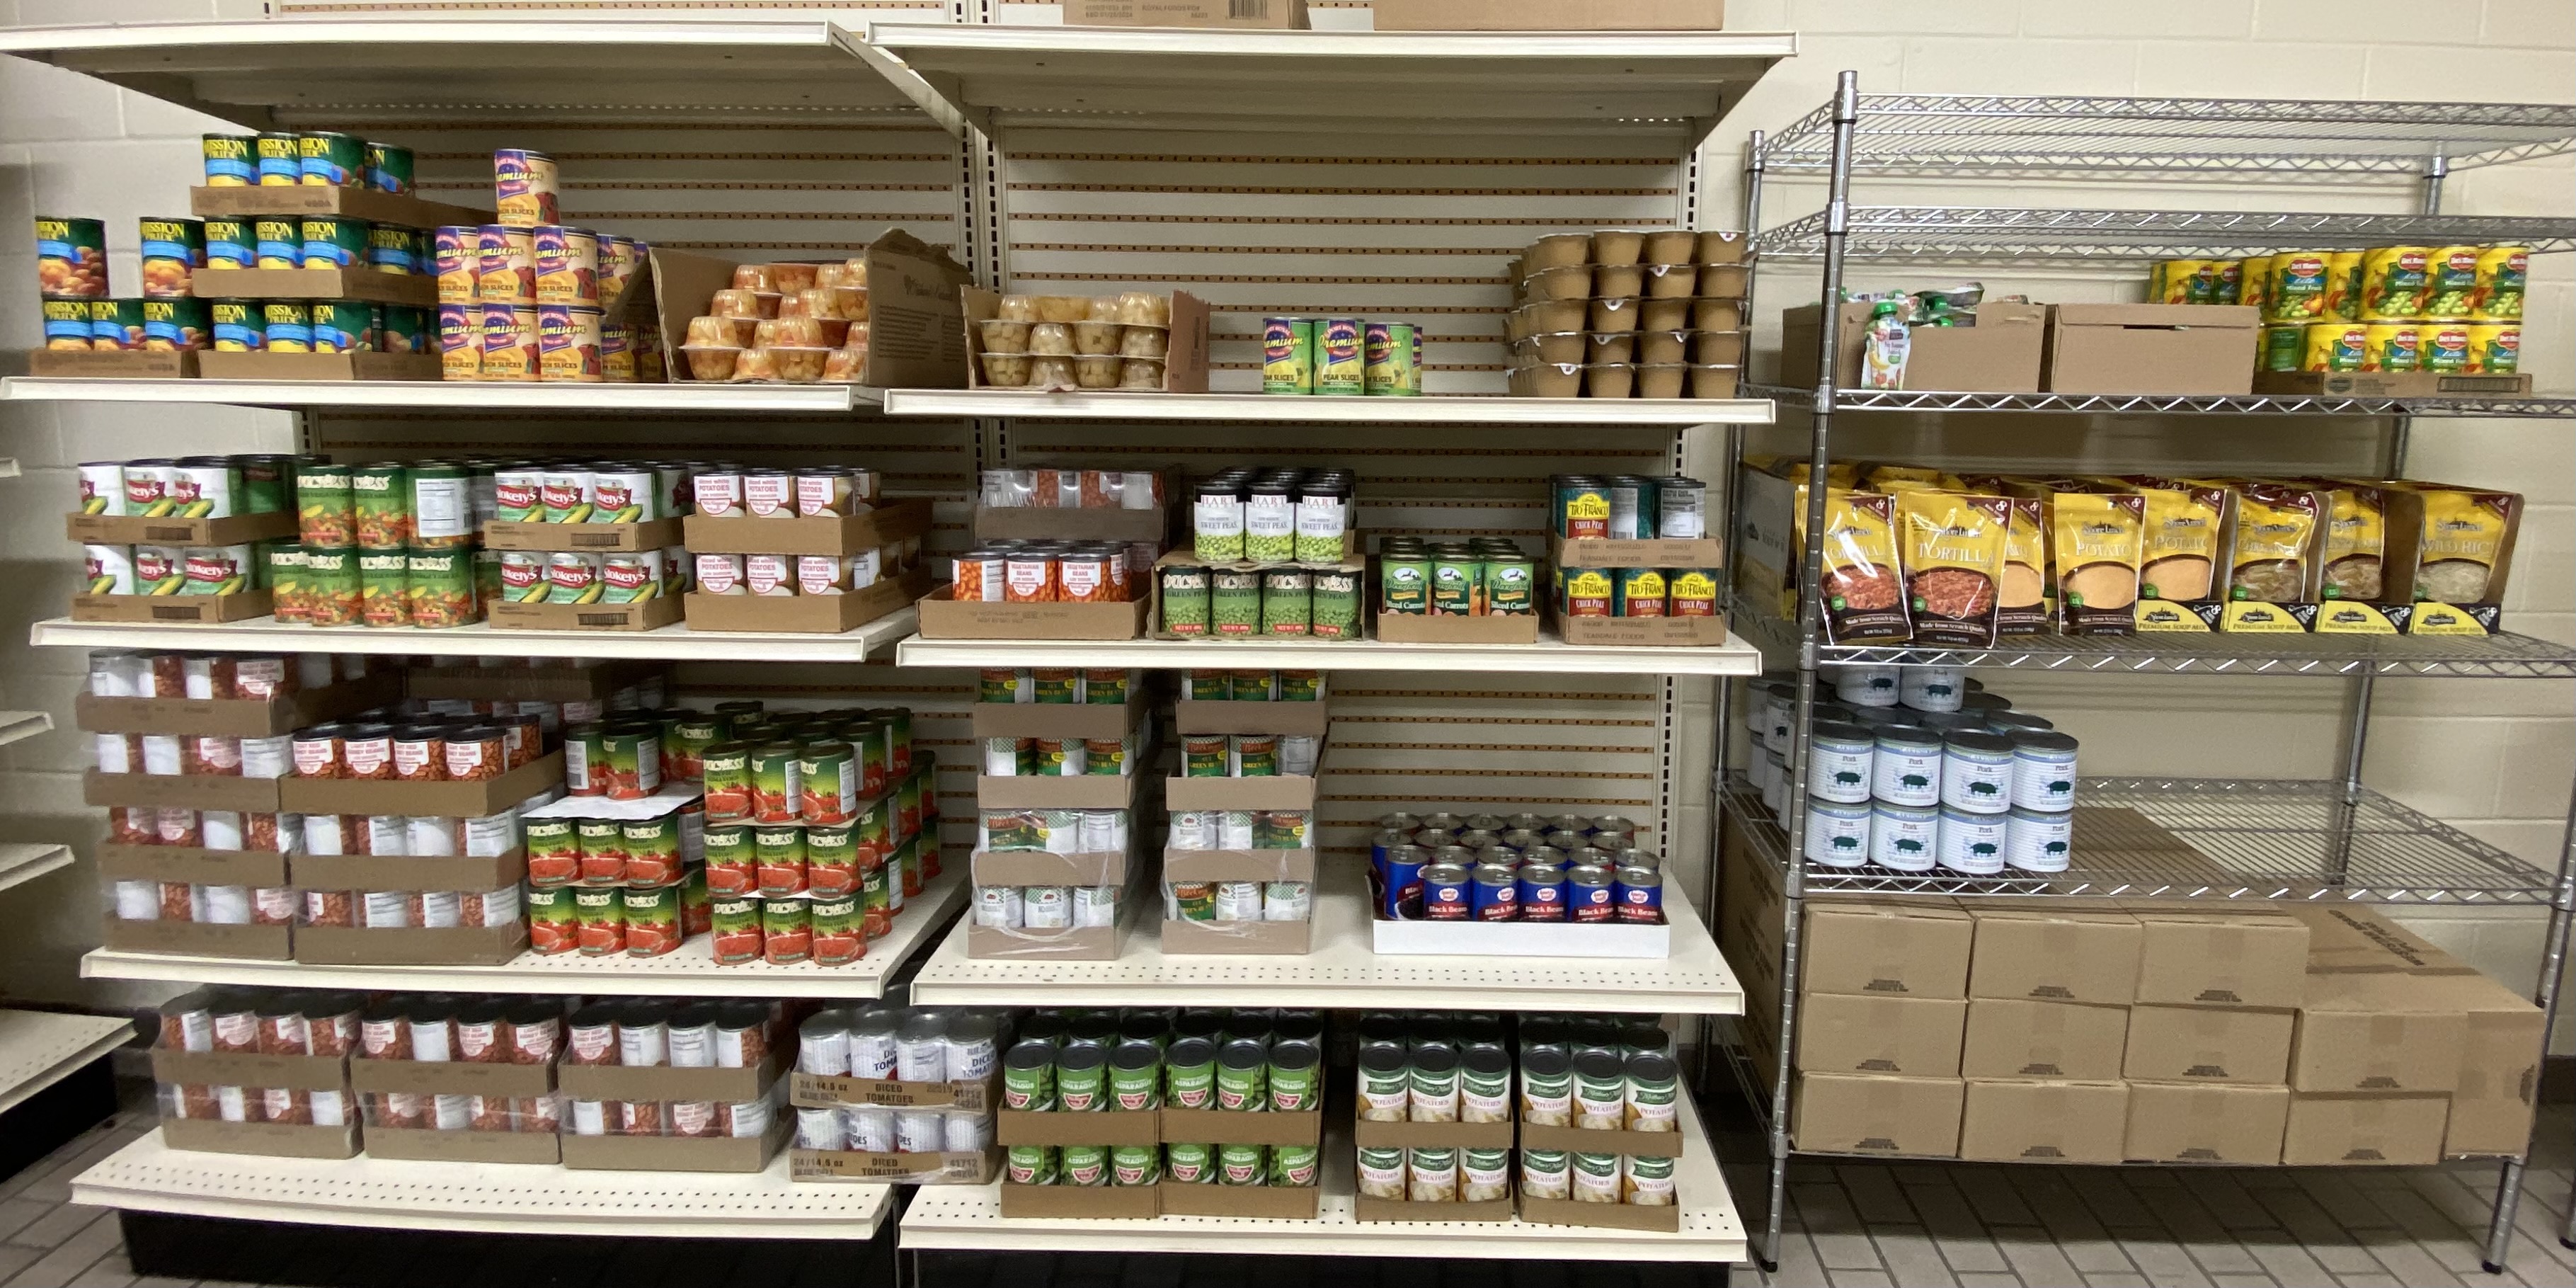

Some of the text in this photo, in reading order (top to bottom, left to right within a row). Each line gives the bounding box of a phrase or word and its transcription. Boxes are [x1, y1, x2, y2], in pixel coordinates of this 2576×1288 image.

[2211, 491, 2221, 501] 8
[2497, 496, 2508, 506] 8
[1201, 496, 1236, 508] HART
[1252, 496, 1286, 508] HART
[1303, 497, 1337, 508] HART
[1875, 498, 1886, 511] 8
[1995, 501, 2008, 511] 8
[2030, 501, 2039, 513] 8
[2131, 498, 2141, 508] 8
[1201, 521, 1238, 530] SWEET PEAS
[1251, 521, 1288, 530] SWEET PEAS
[1575, 520, 1604, 530] CHICK PEAS
[1576, 599, 1605, 609] CHICK PEAS
[1635, 600, 1651, 609] CHICK
[1679, 600, 1709, 610] CHICK PEAS
[2211, 605, 2221, 615] 8
[1429, 905, 1448, 914] Black
[1485, 905, 1505, 916] Black
[1525, 905, 1547, 914] Black
[1578, 906, 1598, 916] Black
[1618, 905, 1637, 915] Black
[874, 1055, 897, 1071] TOMA
[875, 1083, 903, 1093] DICED
[866, 1093, 914, 1104] TOMATOES
[871, 1158, 898, 1167] DICED
[861, 1167, 910, 1177] TOMATOES
